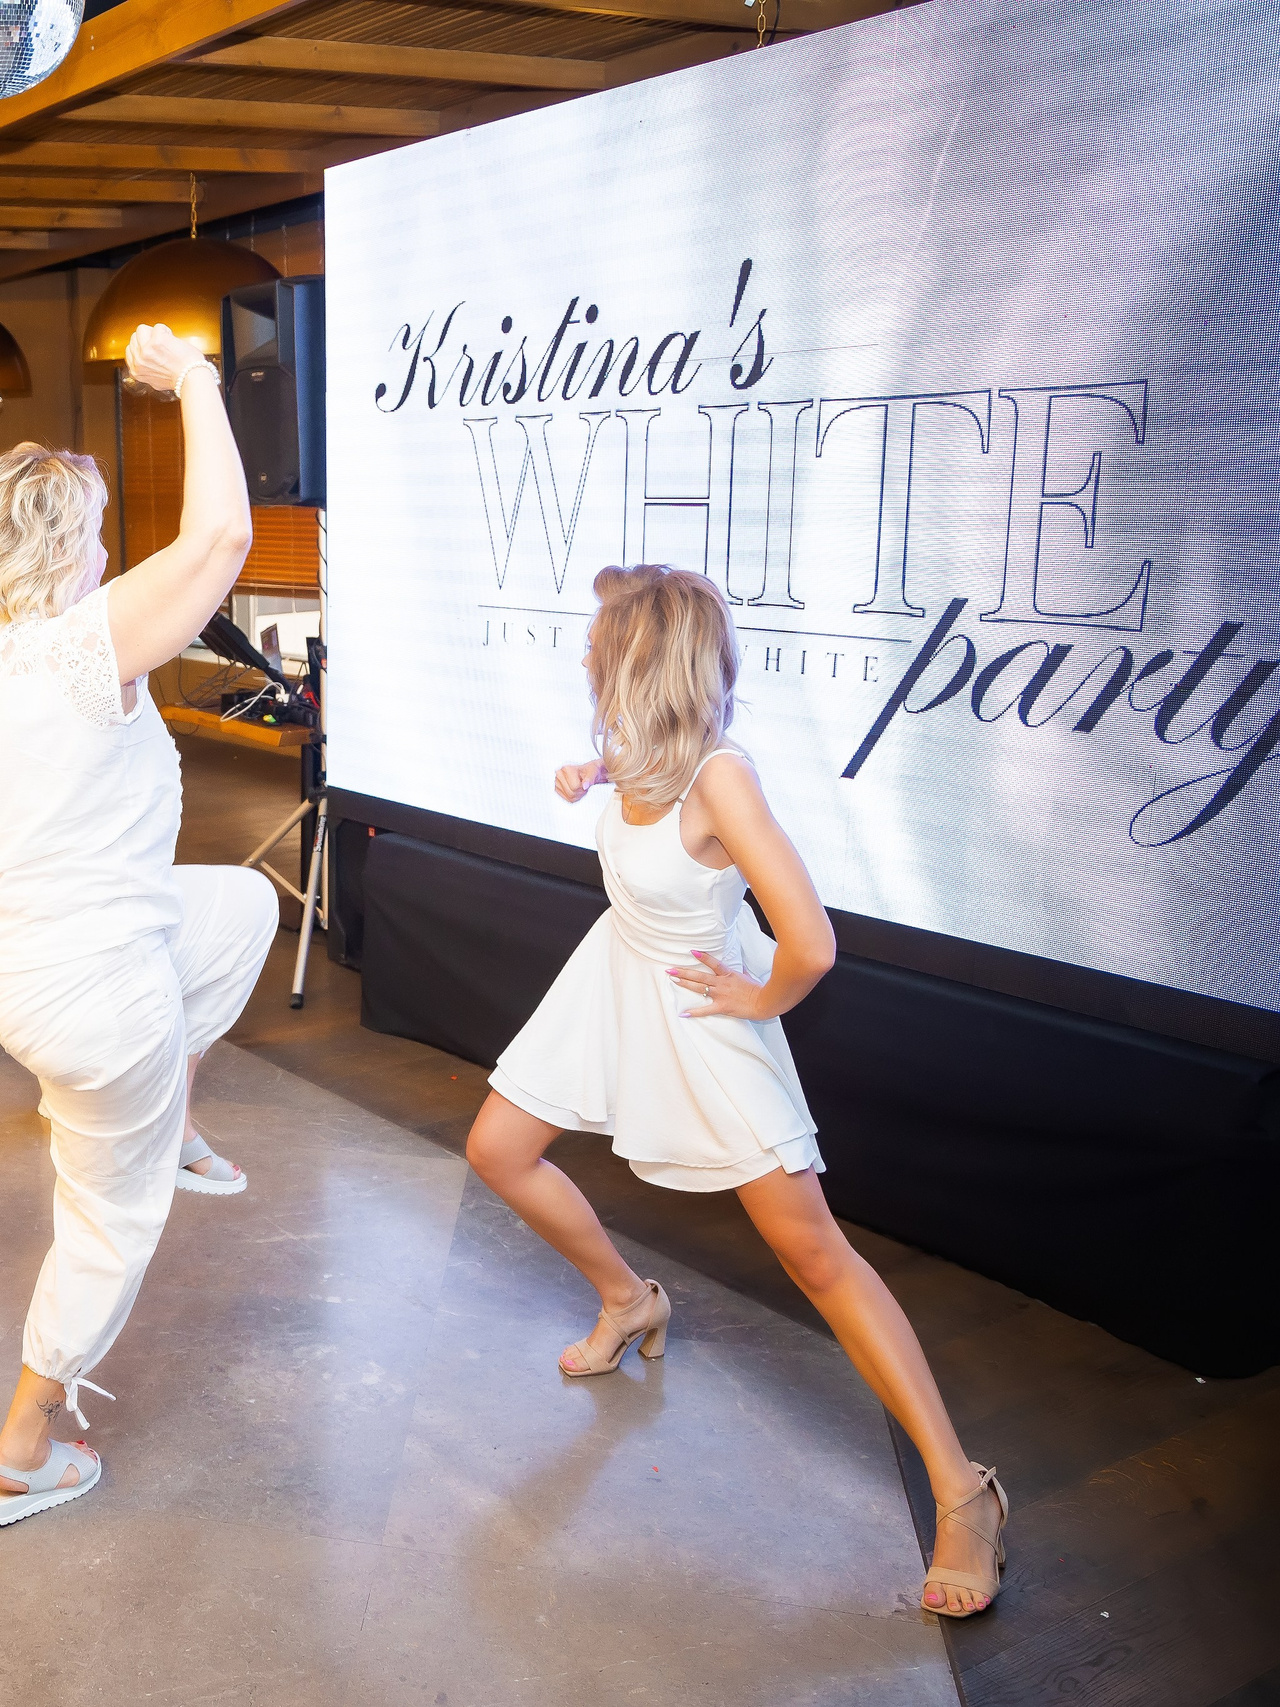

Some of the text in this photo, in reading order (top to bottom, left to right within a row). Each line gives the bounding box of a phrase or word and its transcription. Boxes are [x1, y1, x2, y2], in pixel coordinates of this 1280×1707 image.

[375, 258, 774, 413] Kristina's
[463, 379, 1151, 632] WHITE
[482, 620, 879, 683] JUST HITE
[839, 597, 1280, 848] party
